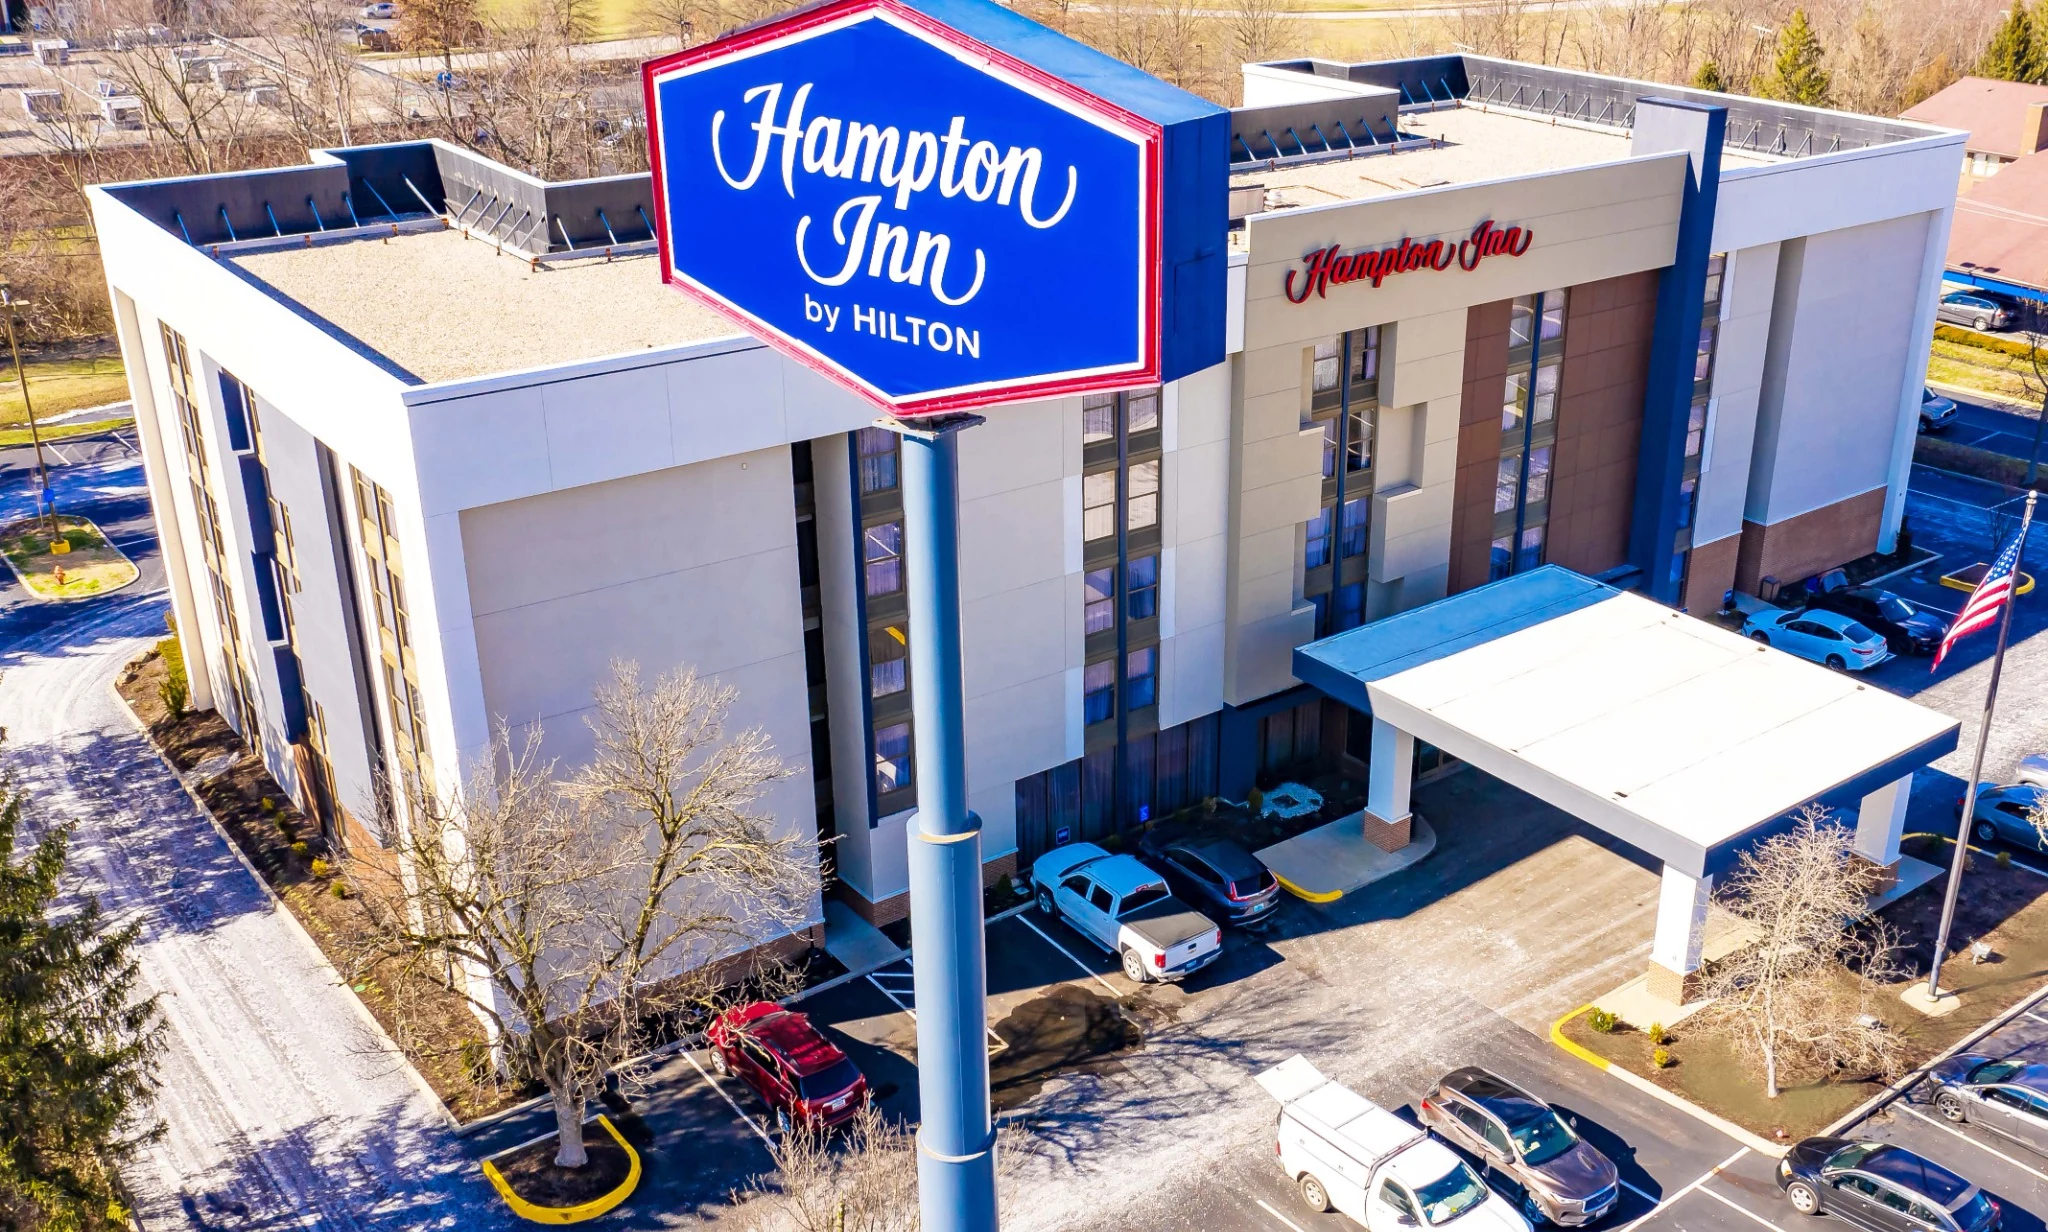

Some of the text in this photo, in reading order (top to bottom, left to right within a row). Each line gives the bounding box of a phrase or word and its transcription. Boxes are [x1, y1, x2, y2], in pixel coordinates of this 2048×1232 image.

[712, 83, 1077, 229] Hampton
[796, 196, 985, 305] Inn
[1285, 220, 1533, 304] Hampton Inn
[805, 294, 980, 359] by HILTON
